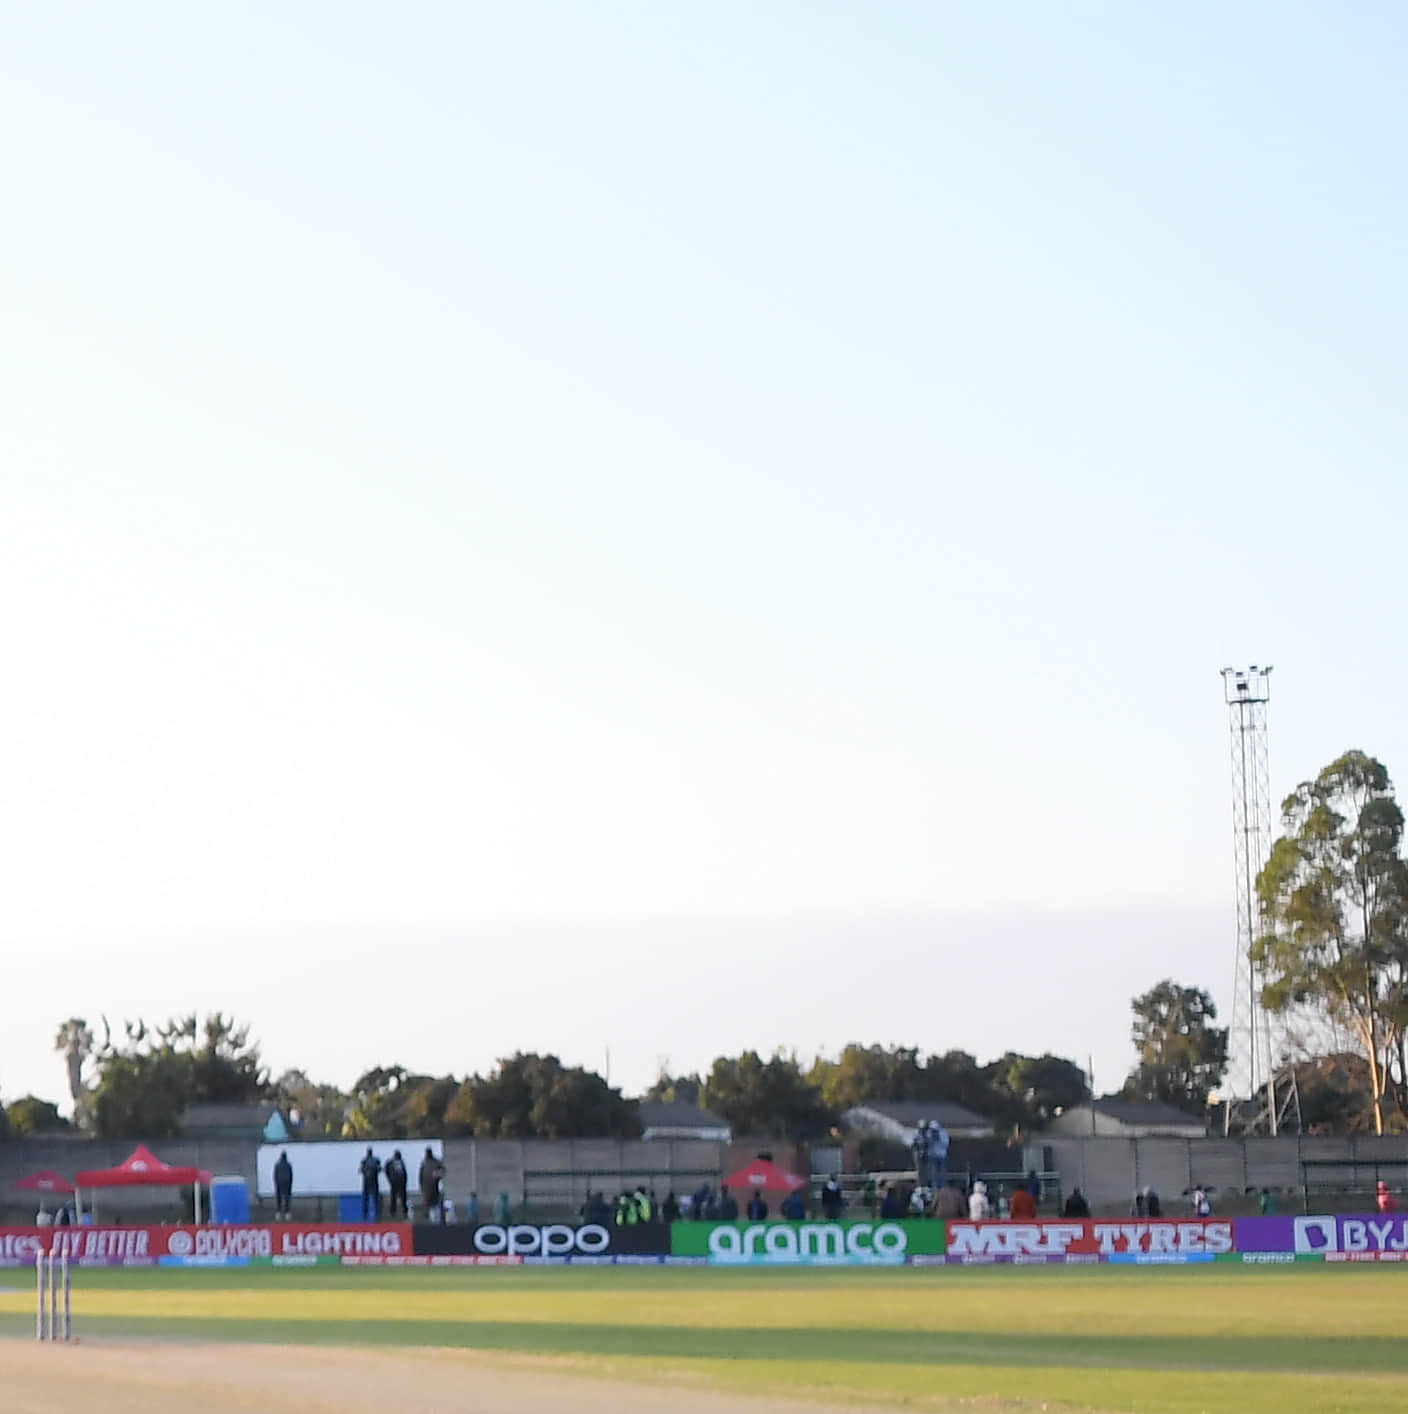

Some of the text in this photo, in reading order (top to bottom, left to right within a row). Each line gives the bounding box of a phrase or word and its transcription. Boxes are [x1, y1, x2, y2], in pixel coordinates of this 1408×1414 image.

[282, 1231, 401, 1255] LIGHTING
[473, 1224, 610, 1256] oppo
[708, 1224, 908, 1258] aramco
[947, 1223, 1233, 1255] MRF TYRES
[1343, 1219, 1408, 1250] BYJ
